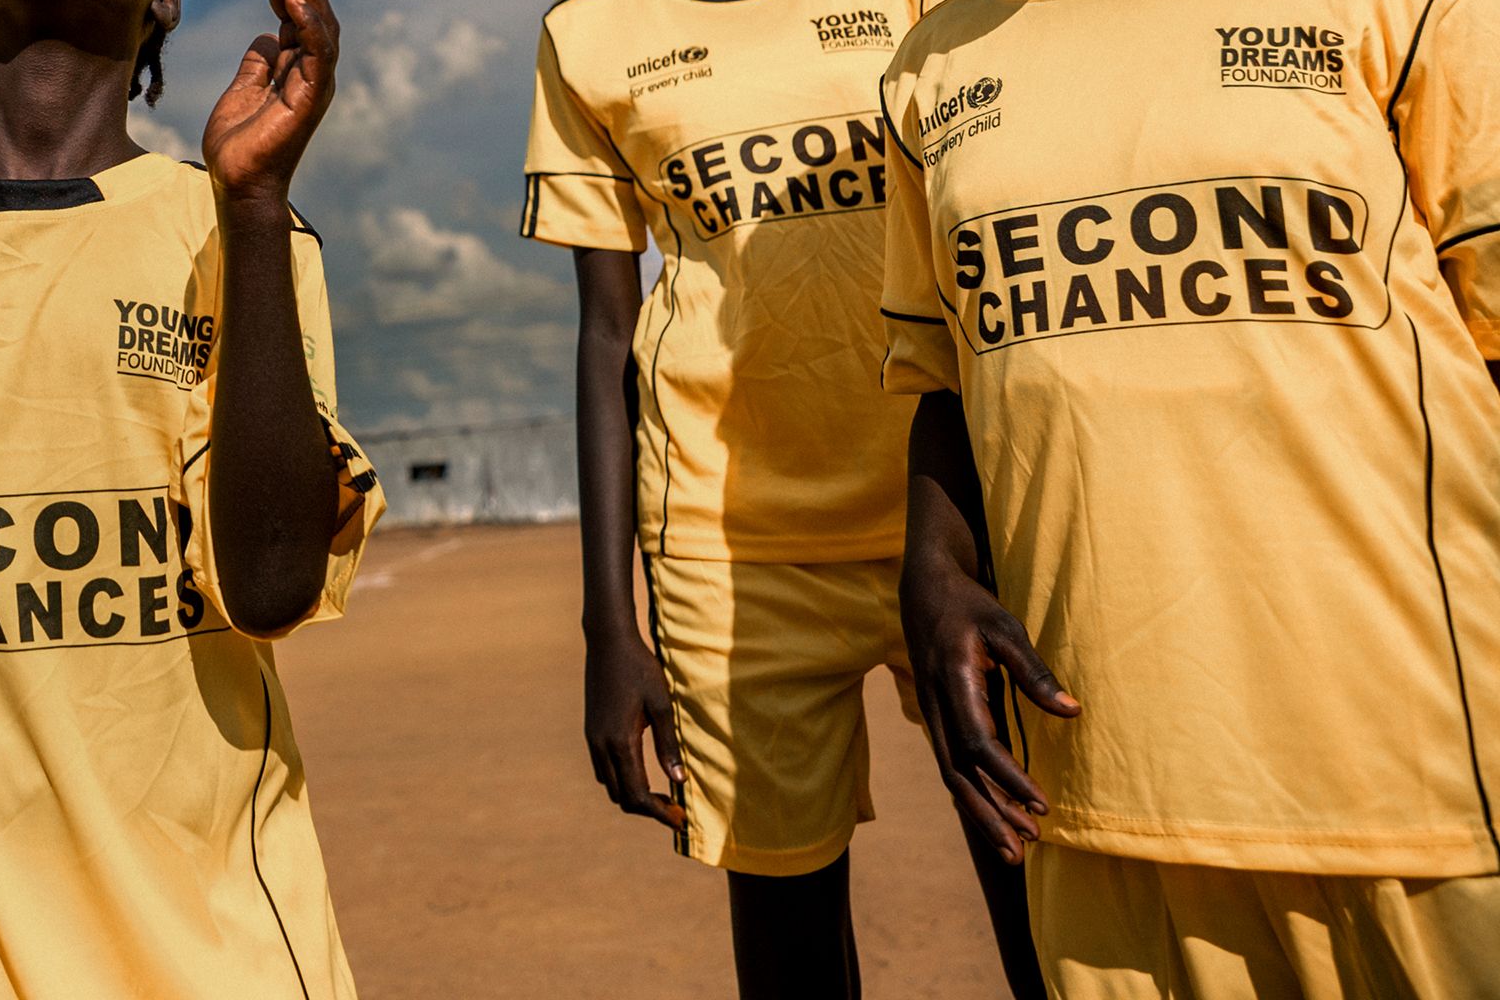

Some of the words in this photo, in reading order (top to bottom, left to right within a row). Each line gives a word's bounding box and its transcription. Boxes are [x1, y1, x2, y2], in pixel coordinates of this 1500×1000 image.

[810, 10, 887, 29] YOUNG
[818, 24, 891, 41] DREAMS
[821, 39, 894, 50] FOUNDATION
[1215, 26, 1344, 48] YOUNG
[627, 49, 676, 78] unicef
[1221, 47, 1343, 72] DREAMS
[648, 76, 679, 92] every
[683, 67, 712, 81] child
[1221, 68, 1342, 88] FOUNDATION
[924, 151, 940, 168] for
[968, 112, 1001, 137] child
[667, 117, 884, 199] SECON
[956, 186, 1361, 289] SECOND
[978, 258, 1353, 344] CHANCES
[114, 299, 213, 341] YOUNG
[118, 325, 210, 368] DREAMS
